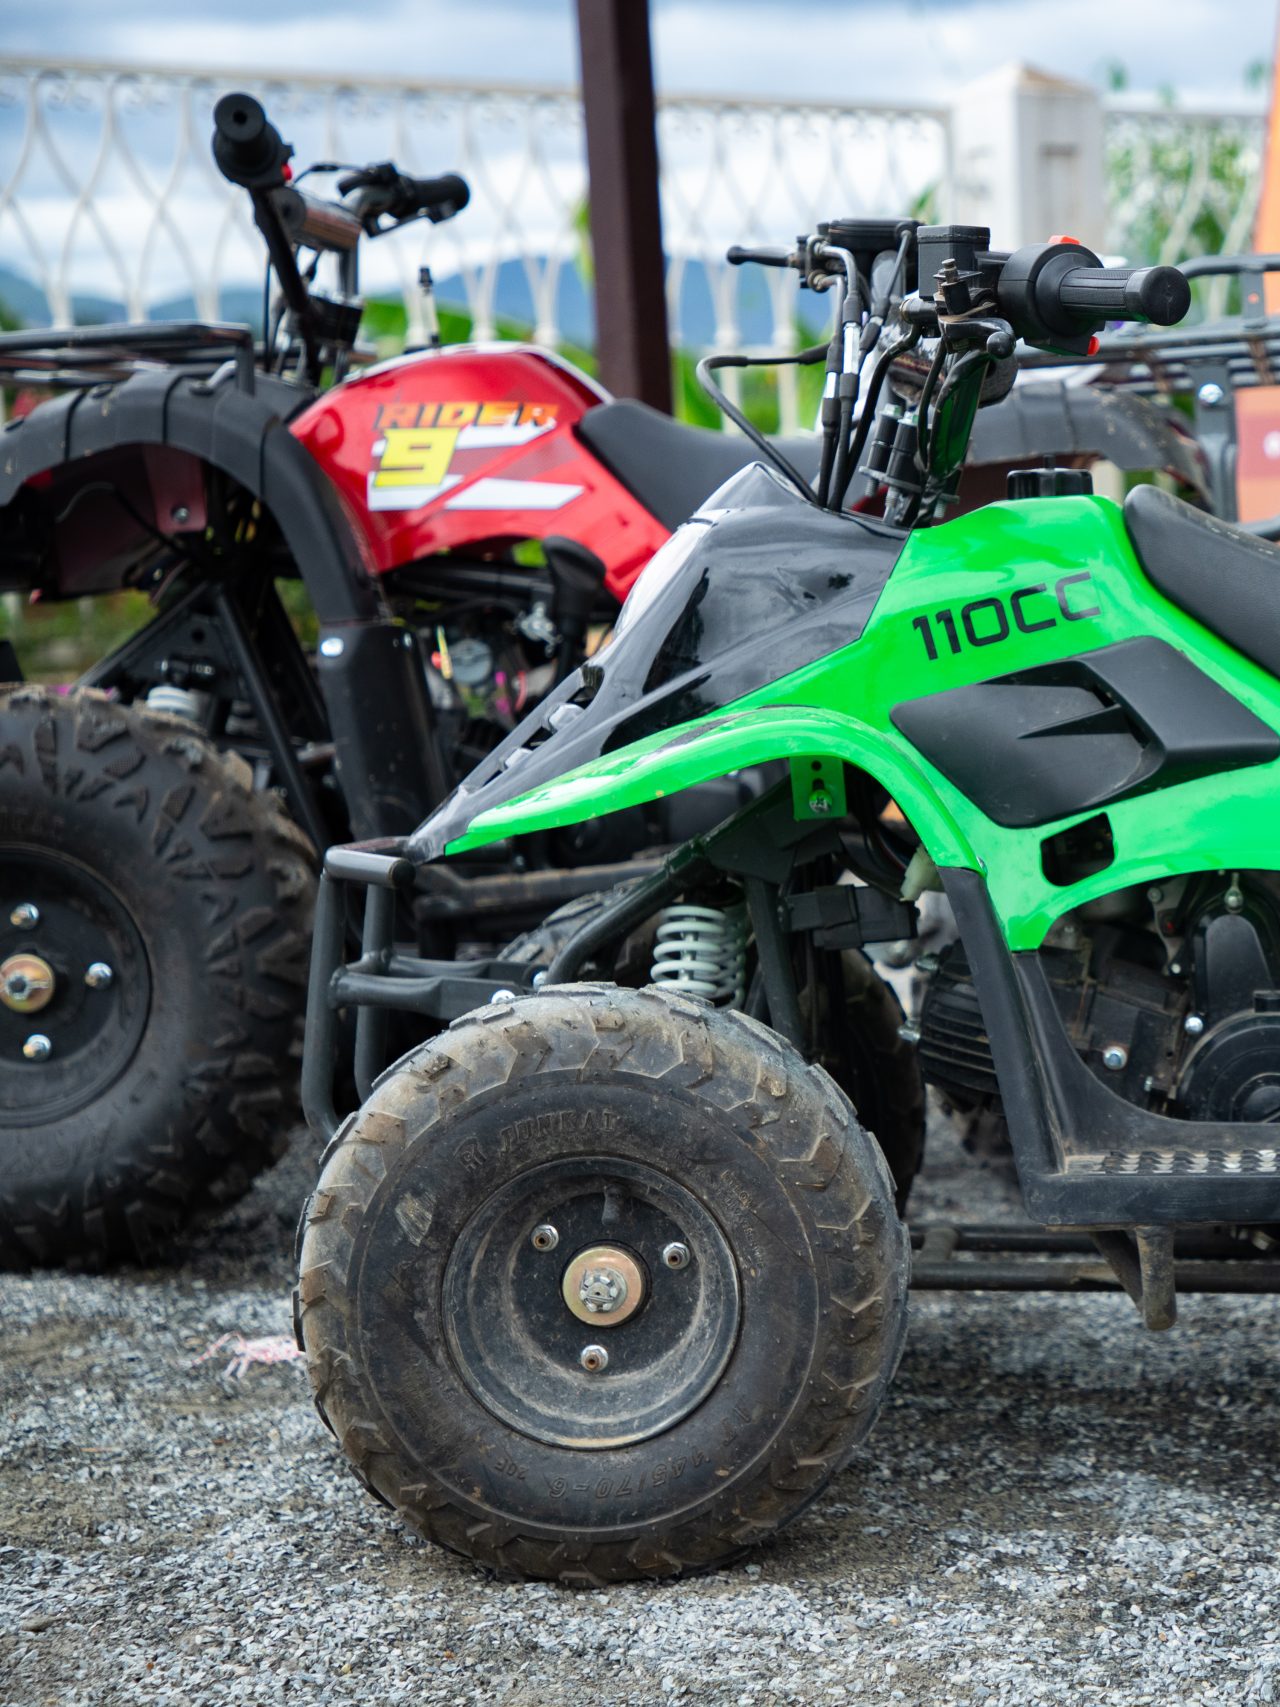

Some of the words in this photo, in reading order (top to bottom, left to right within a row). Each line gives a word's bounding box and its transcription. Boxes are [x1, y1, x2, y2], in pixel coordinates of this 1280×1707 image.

[371, 402, 559, 429] RIDER
[374, 427, 461, 488] 9
[911, 570, 1101, 662] 110CC
